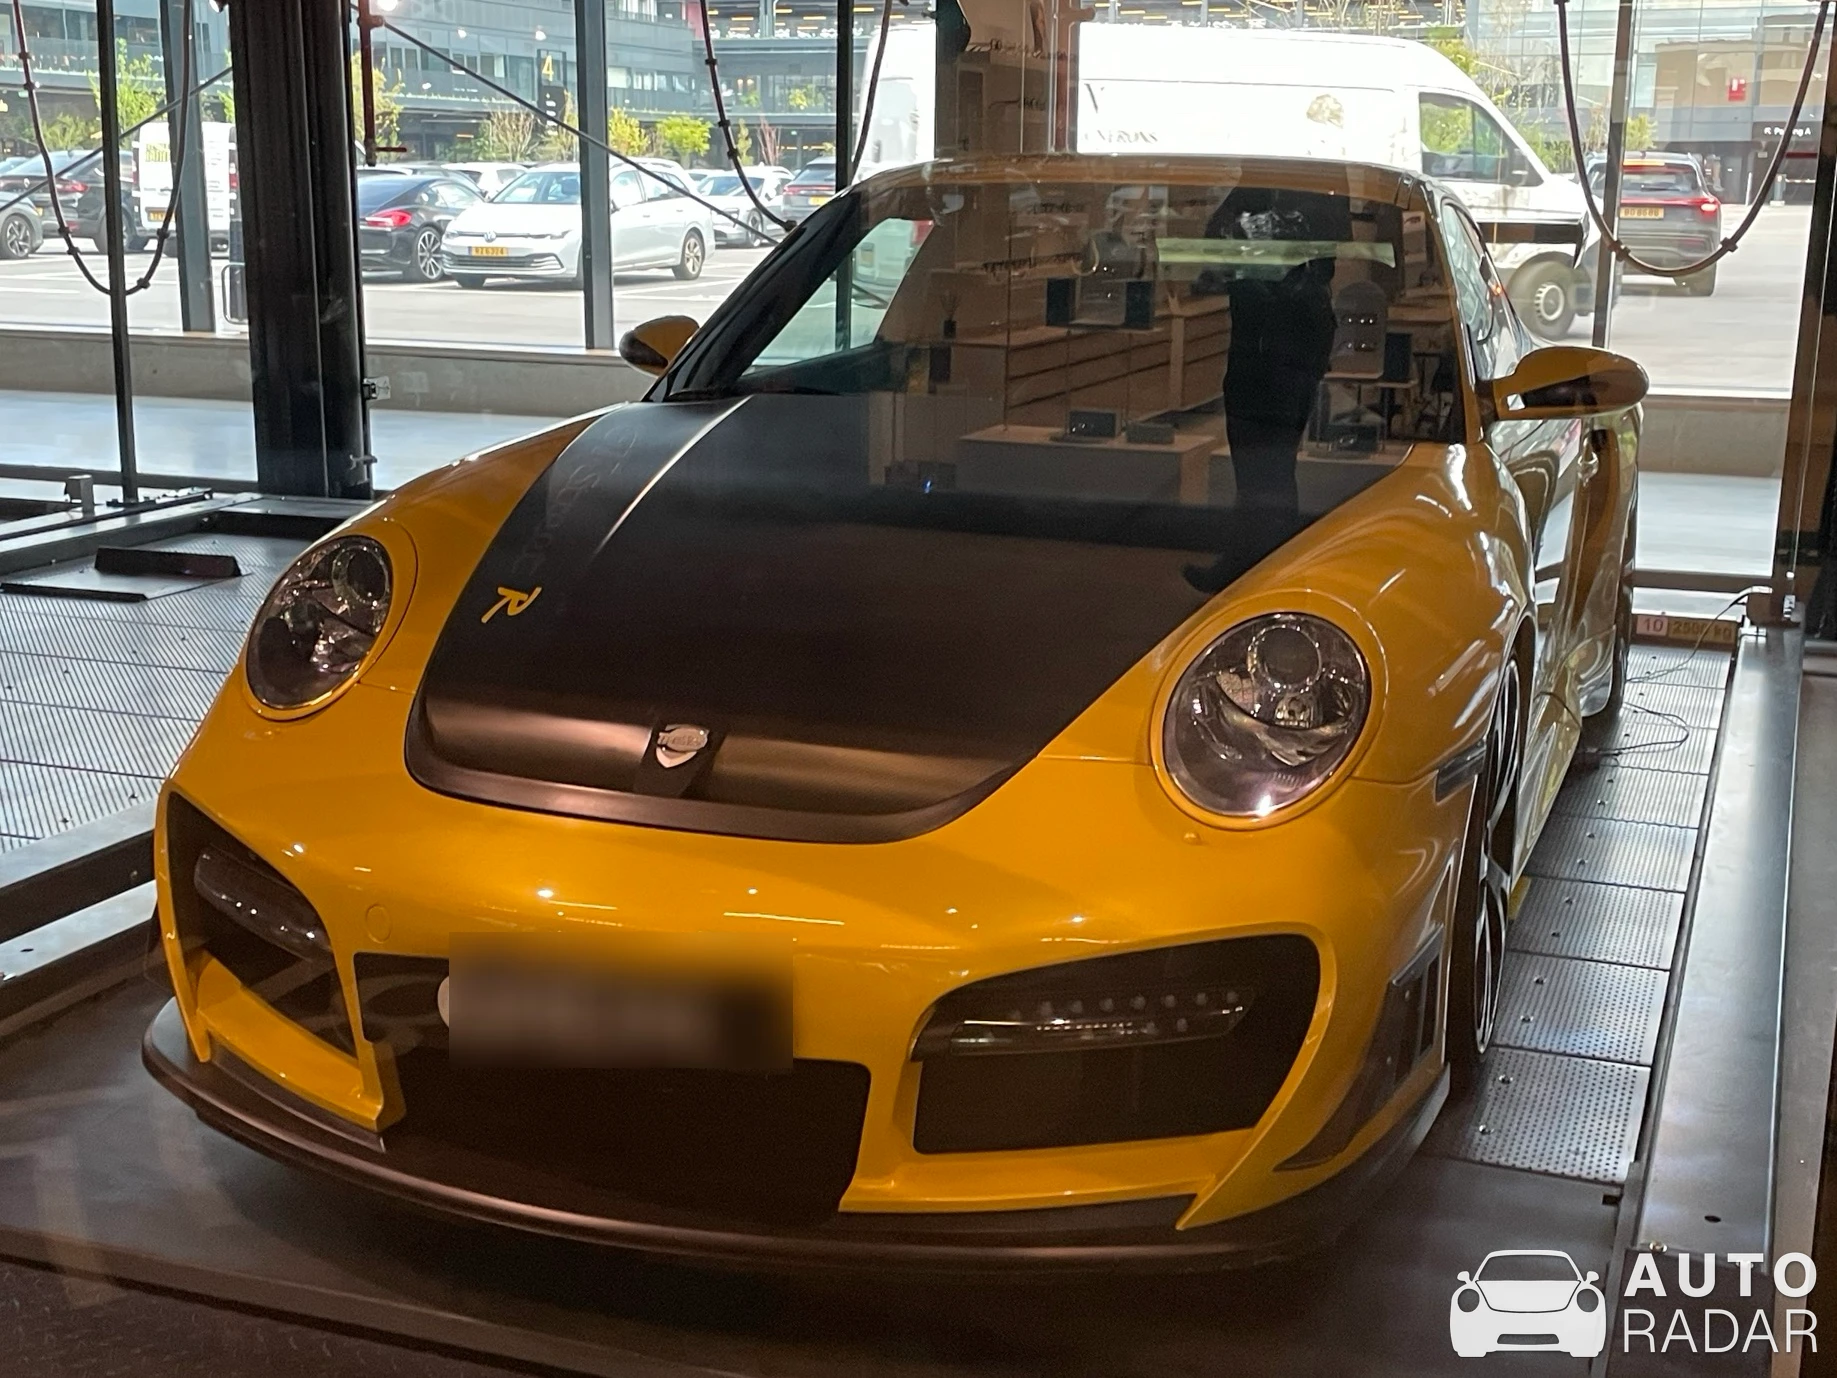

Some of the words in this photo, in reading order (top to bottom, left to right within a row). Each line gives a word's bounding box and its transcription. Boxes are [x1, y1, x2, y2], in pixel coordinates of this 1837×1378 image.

[541, 55, 555, 82] 4
[481, 586, 542, 623] R
[1643, 618, 1664, 633] 10
